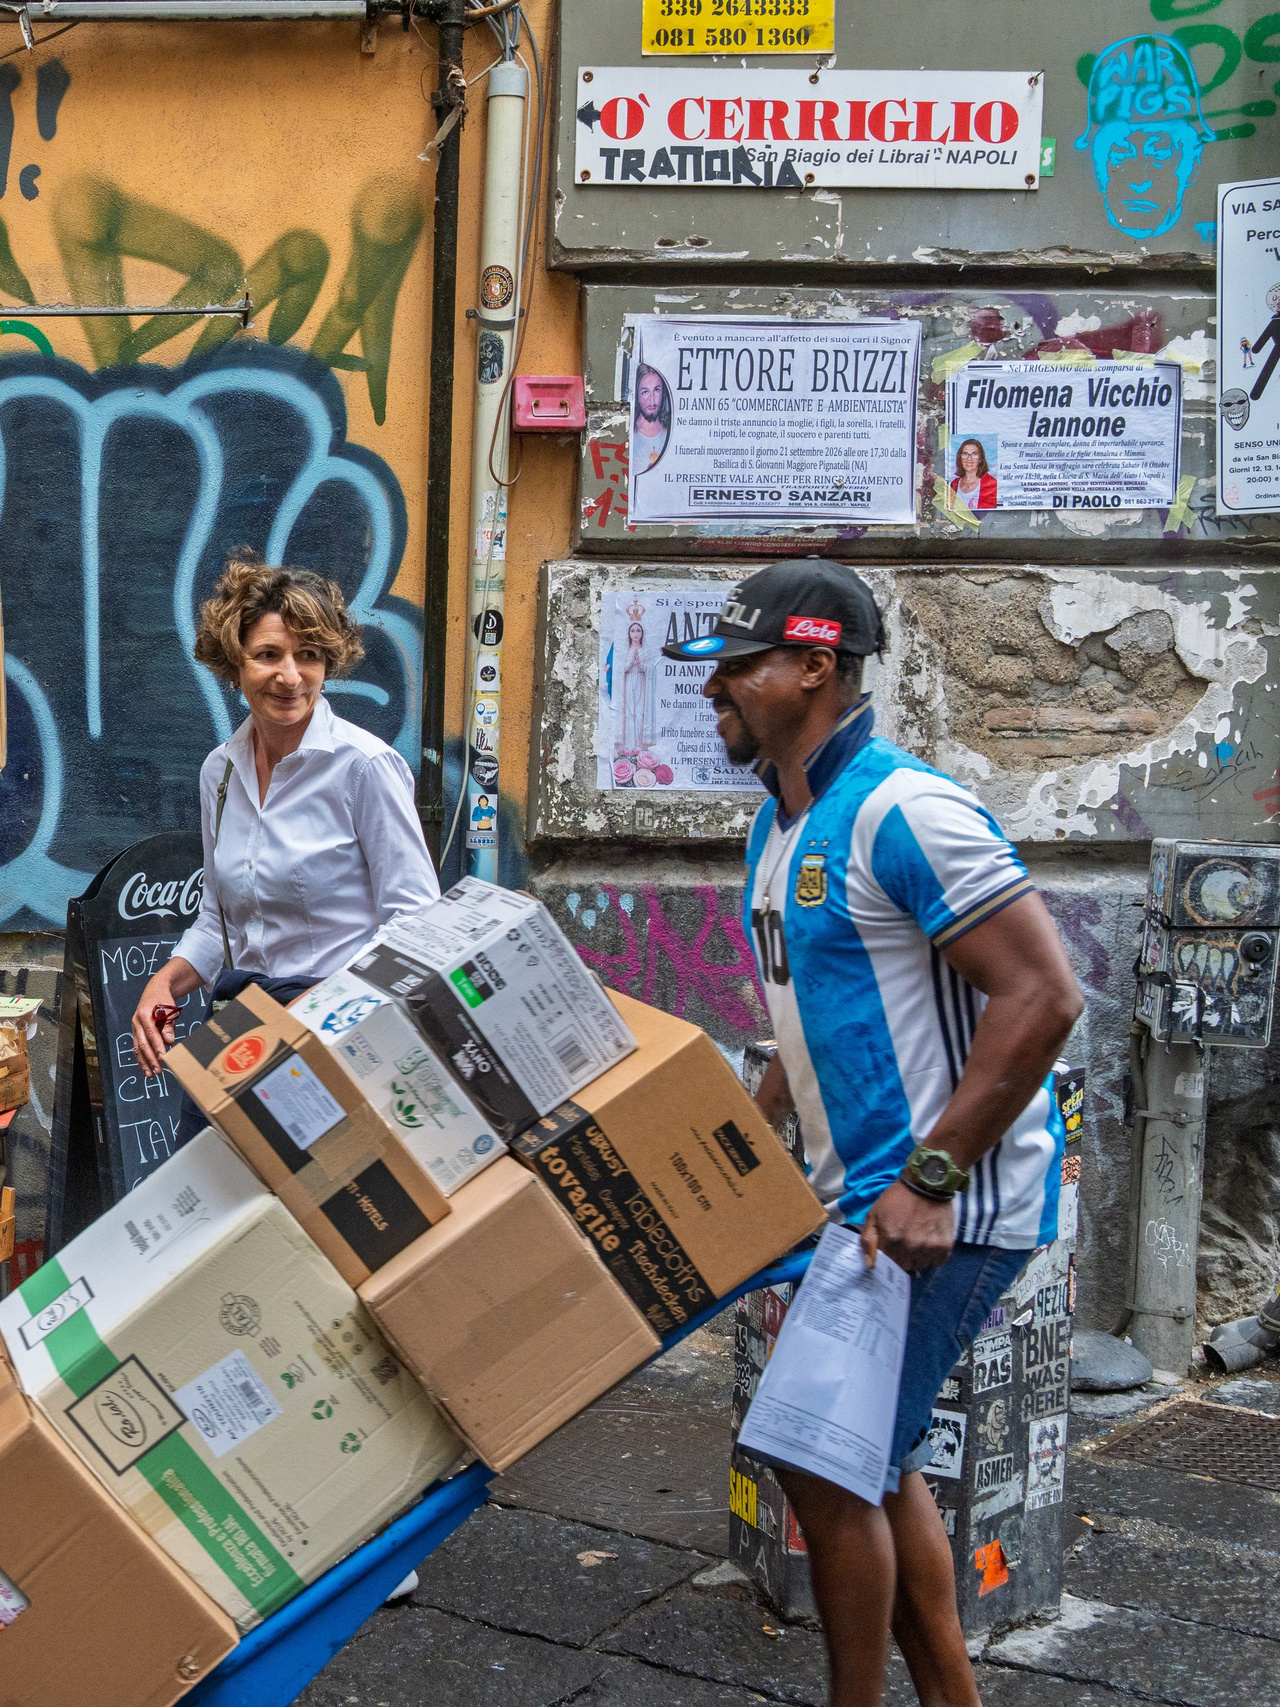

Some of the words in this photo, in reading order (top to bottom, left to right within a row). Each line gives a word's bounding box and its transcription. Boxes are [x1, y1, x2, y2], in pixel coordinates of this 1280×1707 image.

[661, 0, 702, 16] 339
[712, 0, 810, 16] 2643333
[655, 28, 695, 46] 081
[705, 28, 747, 46] 580
[756, 28, 810, 46] 1360
[1098, 44, 1186, 87] WAR
[1097, 83, 1192, 121] PIGS
[667, 95, 1019, 145] CERRIGLIO
[599, 144, 804, 187] TRATTORIA
[746, 148, 779, 163] San
[784, 148, 841, 167] Biagio
[846, 149, 873, 164] dei
[878, 149, 929, 165] Librai
[946, 150, 1018, 165] NAPOLI
[1232, 202, 1257, 215] VIA
[682, 334, 714, 342] venuto
[813, 335, 828, 343] dei
[852, 335, 870, 344] cari
[881, 336, 912, 345] Signor
[677, 347, 795, 392] ETTORE
[811, 349, 908, 393] BRIZZI
[1008, 364, 1021, 373] Nel
[1024, 363, 1072, 373] TRIGESIMO
[1074, 363, 1092, 372] della
[1094, 364, 1133, 374] scomparsa
[679, 398, 689, 411] DI
[691, 398, 716, 411] ANNI
[718, 398, 729, 411] 65
[817, 399, 824, 412] E
[964, 378, 1073, 409] Filomena
[1088, 376, 1173, 407] Vicchio
[677, 417, 688, 426] Ne
[688, 417, 712, 426] danno
[721, 417, 740, 427] triste
[742, 418, 777, 427] annuncio
[787, 419, 815, 430] moglie,
[820, 419, 837, 430] figli,
[846, 420, 874, 429] sorella,
[879, 420, 906, 430] fratelli,
[713, 429, 738, 439] nipoti,
[748, 430, 779, 440] cognate,
[787, 431, 816, 439] suocero
[824, 430, 851, 440] parenti
[853, 431, 871, 440] tutti.
[1027, 410, 1126, 438] Iannone
[679, 445, 705, 455] funerali
[707, 447, 749, 456] muoveranno
[756, 446, 778, 458] giorno
[780, 447, 788, 456] 21
[789, 447, 823, 457] settembre
[825, 447, 843, 457] 2026
[844, 447, 855, 457] alle
[857, 449, 868, 458] ore
[890, 448, 907, 458] dalla
[1042, 440, 1071, 448] esemplare,
[1234, 440, 1263, 449] SENSO
[713, 459, 739, 469] Basilica
[756, 460, 785, 469] Giovanni
[786, 460, 818, 472] Maggiore
[819, 460, 850, 472] Pignatelli
[851, 460, 868, 472] (NA)
[1012, 462, 1029, 470] Santa
[1031, 462, 1047, 470] Messa
[1121, 461, 1140, 469] Sabato
[1149, 461, 1170, 469] Ottobre
[664, 474, 673, 483] IL
[676, 474, 727, 483] PRESENTE
[729, 474, 753, 483] VALE
[756, 474, 790, 484] ANCHE
[792, 475, 811, 484] PER
[693, 489, 782, 501] ERNESTO
[788, 490, 872, 502] SANZARI
[1052, 495, 1068, 508] DI
[1072, 495, 1121, 508] PAOLO
[656, 598, 669, 607] Si
[787, 619, 838, 641] Lete
[665, 665, 677, 677] DI
[679, 665, 706, 677] ANNI
[661, 699, 672, 709] Ne
[673, 699, 697, 709] danno
[667, 727, 679, 737] rito
[680, 727, 705, 738] funebre
[677, 742, 698, 753] Chiesa
[671, 757, 679, 765] IL
[681, 757, 727, 766] PRESENTE
[751, 908, 791, 986] 10
[461, 1039, 491, 1073] ONYX
[1062, 1087, 1084, 1115] SPEZI
[585, 1125, 630, 1178] UBRUSY
[669, 1151, 703, 1197] 100x100
[696, 1193, 712, 1212] cm
[538, 1146, 620, 1252] tovaglie
[356, 1196, 389, 1231] HOTELS
[624, 1187, 707, 1303] Tablecloths
[629, 1239, 689, 1325] Tischdecken
[1025, 1319, 1067, 1369] BNE
[1025, 1362, 1065, 1390] WAS
[1024, 1386, 1065, 1417] HERE
[977, 1456, 1013, 1488] ASMER
[160, 1467, 220, 1537] Professionalità
[729, 1466, 758, 1529] SAEM
[222, 1538, 265, 1588] Eccellenza
[244, 1541, 277, 1578] firmata
